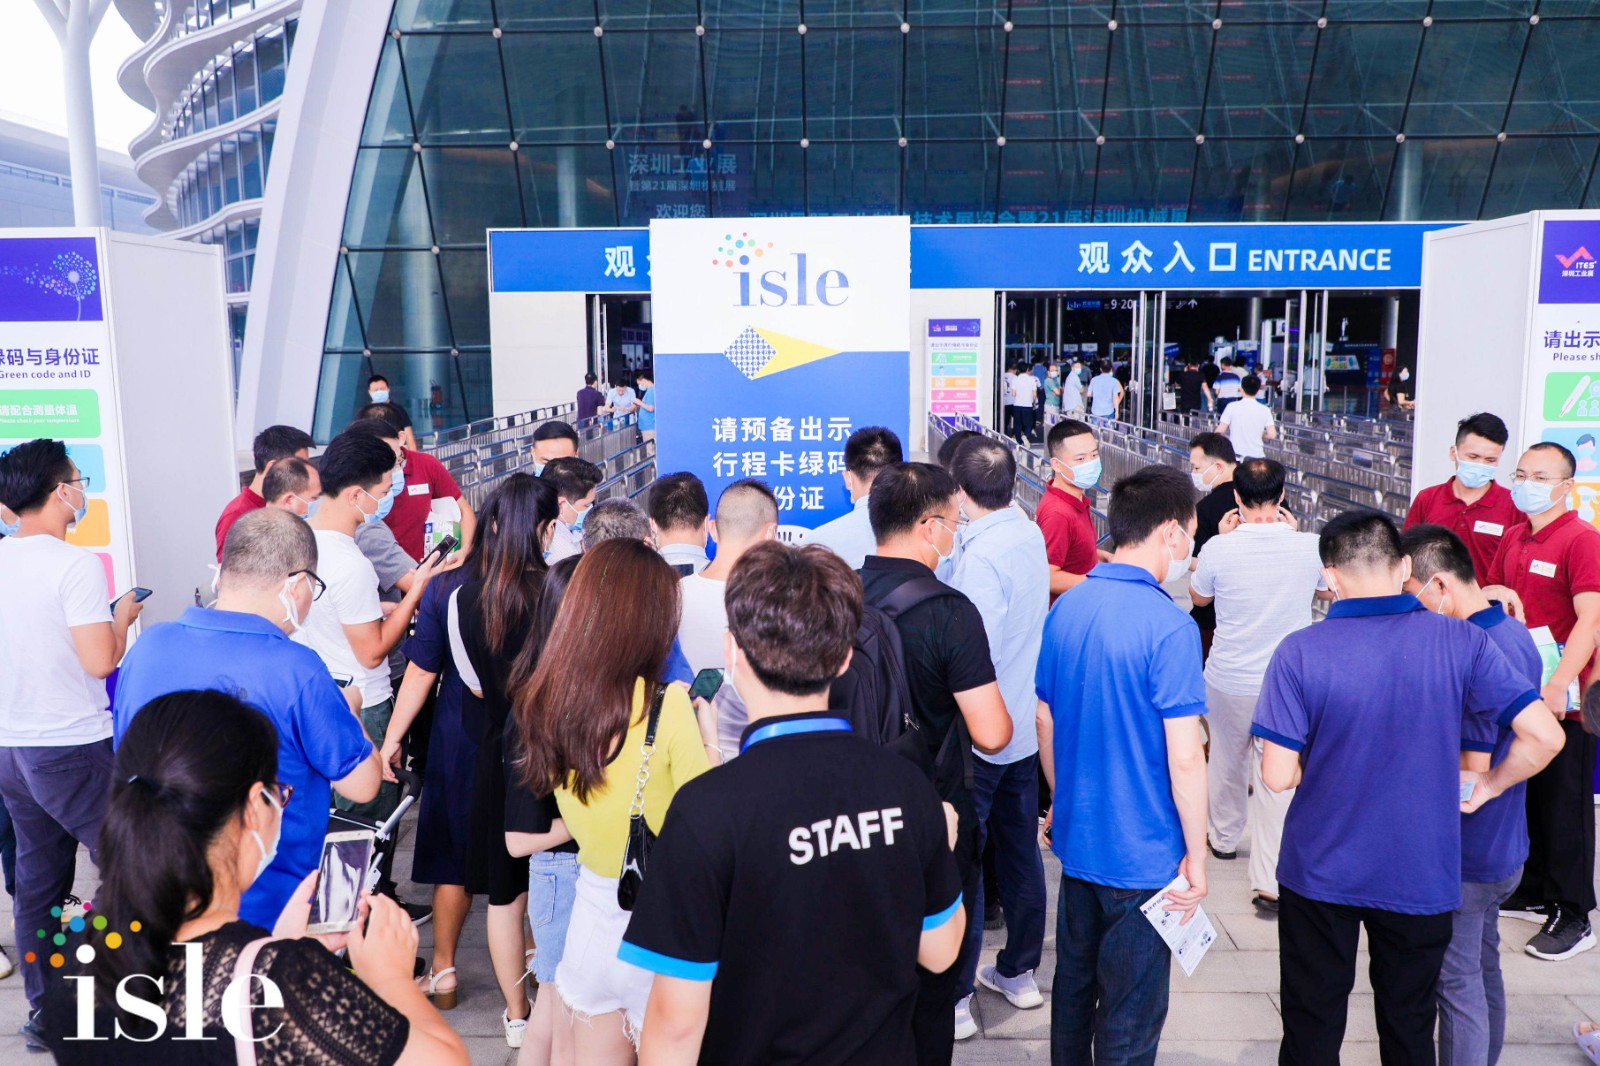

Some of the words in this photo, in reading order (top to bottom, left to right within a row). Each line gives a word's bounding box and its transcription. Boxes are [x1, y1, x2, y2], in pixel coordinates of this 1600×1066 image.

[1077, 240, 1238, 275] 观众入口
[1248, 248, 1393, 272] ENTRANCE
[732, 252, 850, 308] isle
[1544, 330, 1600, 349] 请出示
[1553, 352, 1587, 361] Please
[31, 370, 55, 379] code
[58, 370, 77, 379] and
[80, 370, 91, 378] ID
[712, 416, 852, 442] 请预备出示
[713, 451, 847, 477] 行程卡绿码
[788, 807, 904, 865] STAFF
